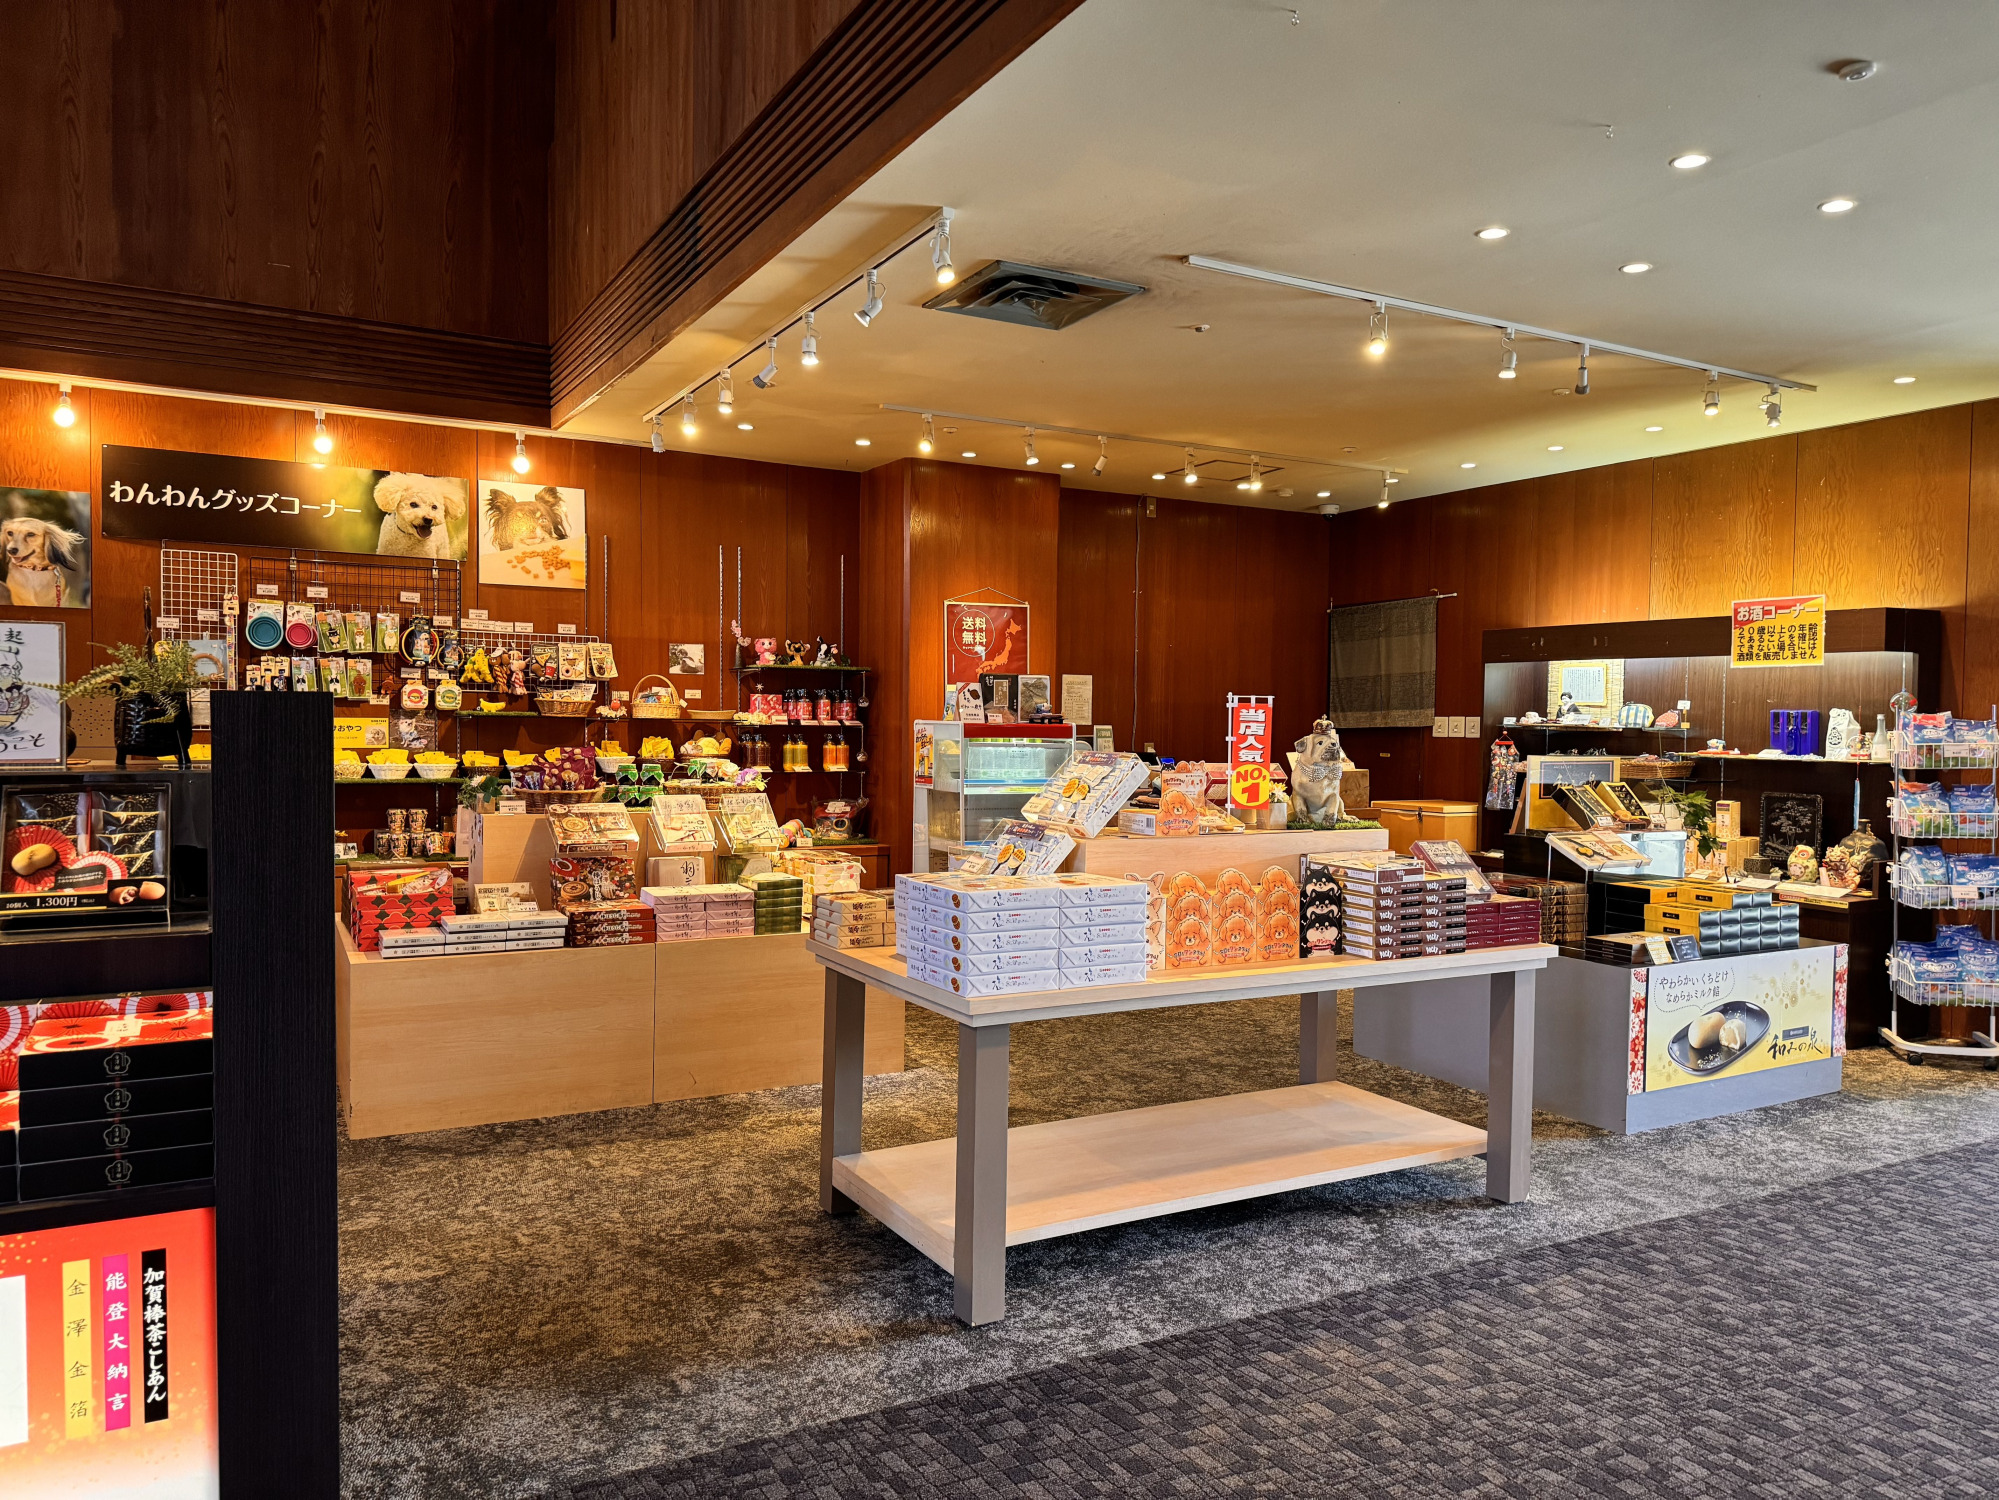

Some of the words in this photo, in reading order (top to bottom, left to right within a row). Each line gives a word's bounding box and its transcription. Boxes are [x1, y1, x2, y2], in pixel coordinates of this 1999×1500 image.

[109, 480, 362, 518] わんわんグッズコーナー
[1736, 603, 1819, 621] お酒コーナー
[961, 616, 987, 631] 送料
[961, 631, 987, 645] 無料
[1737, 642, 1817, 653] できない場合には
[1736, 651, 1817, 661] 酒類を販売しません
[1237, 708, 1266, 763] 当店人気
[1380, 885, 1394, 894] Pocky
[1426, 882, 1440, 891] Pocky
[36, 896, 78, 907] 1,300円
[1426, 894, 1439, 903] Pocky
[1380, 899, 1393, 908] Pocky
[1380, 912, 1393, 920] Pocky
[1426, 907, 1439, 916] Pocky
[1380, 924, 1393, 933] Pocky
[1426, 920, 1439, 929] Pocky
[1380, 937, 1393, 946] Pocky
[1426, 933, 1440, 942] Pocky
[1379, 950, 1393, 958] Pocky
[1426, 945, 1439, 954] Pocky
[143, 1268, 167, 1404] 加賀棒茶こしあん
[105, 1272, 128, 1412] 能登大納言
[66, 1278, 89, 1420] 金澤金箔
